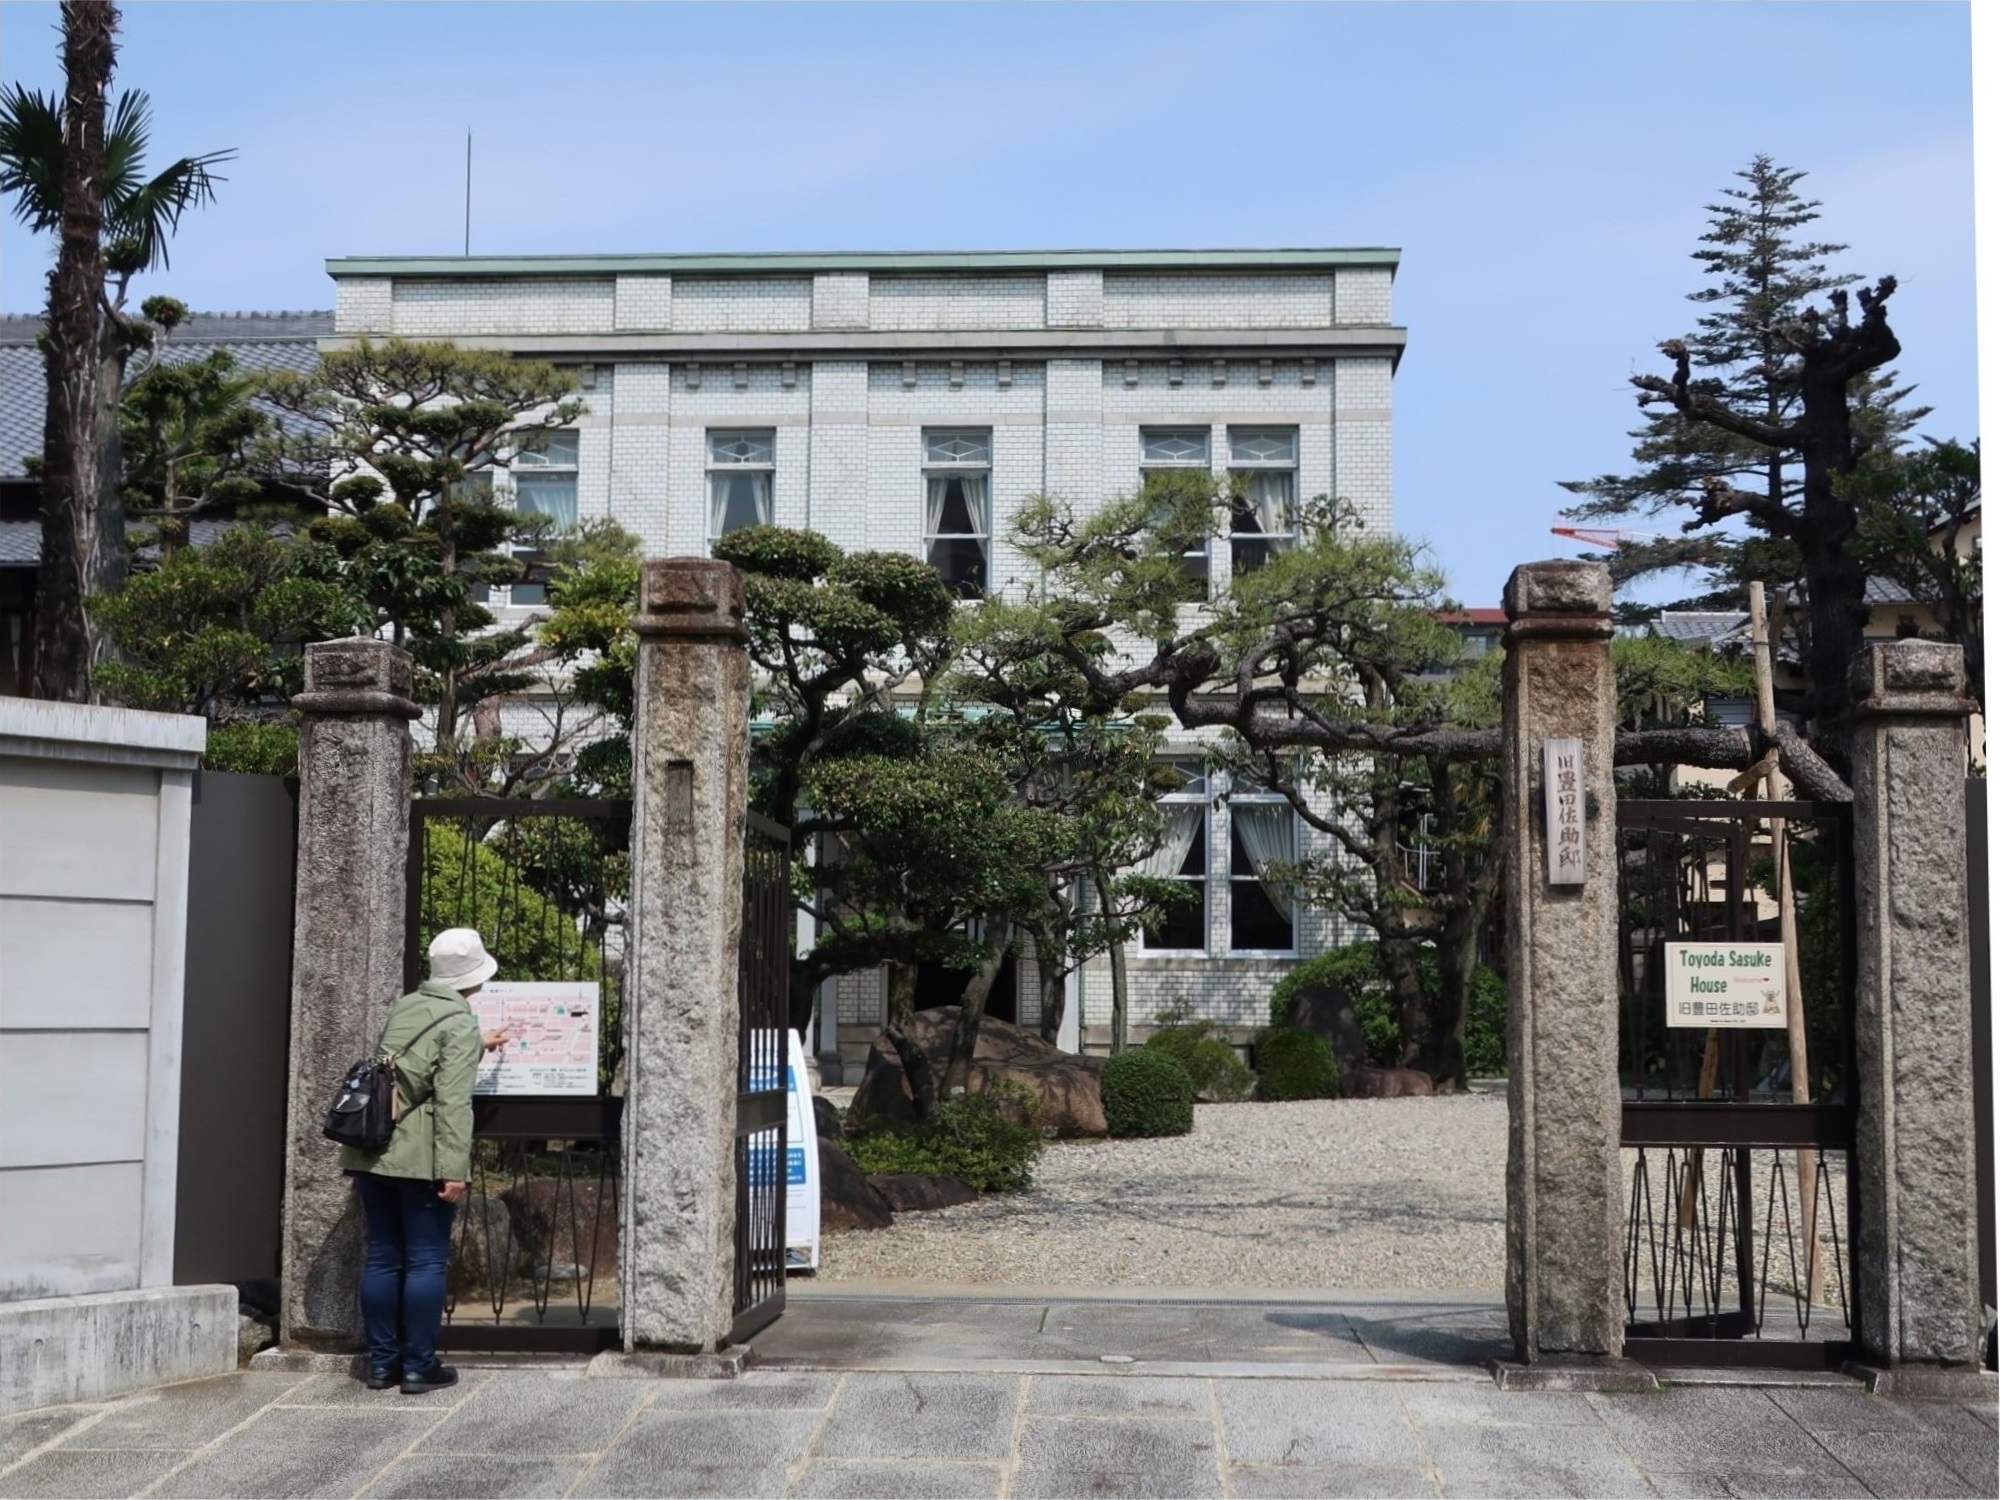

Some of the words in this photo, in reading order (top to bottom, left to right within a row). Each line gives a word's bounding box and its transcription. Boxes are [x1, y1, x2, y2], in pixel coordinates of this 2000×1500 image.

[1557, 755, 1581, 869] 旧豊田佐助邸
[1679, 950, 1725, 969] Toyoda
[1729, 950, 1772, 967] Sasuke
[1690, 976, 1728, 993] House
[1679, 1002, 1759, 1016] 旧豊田佐助邸
